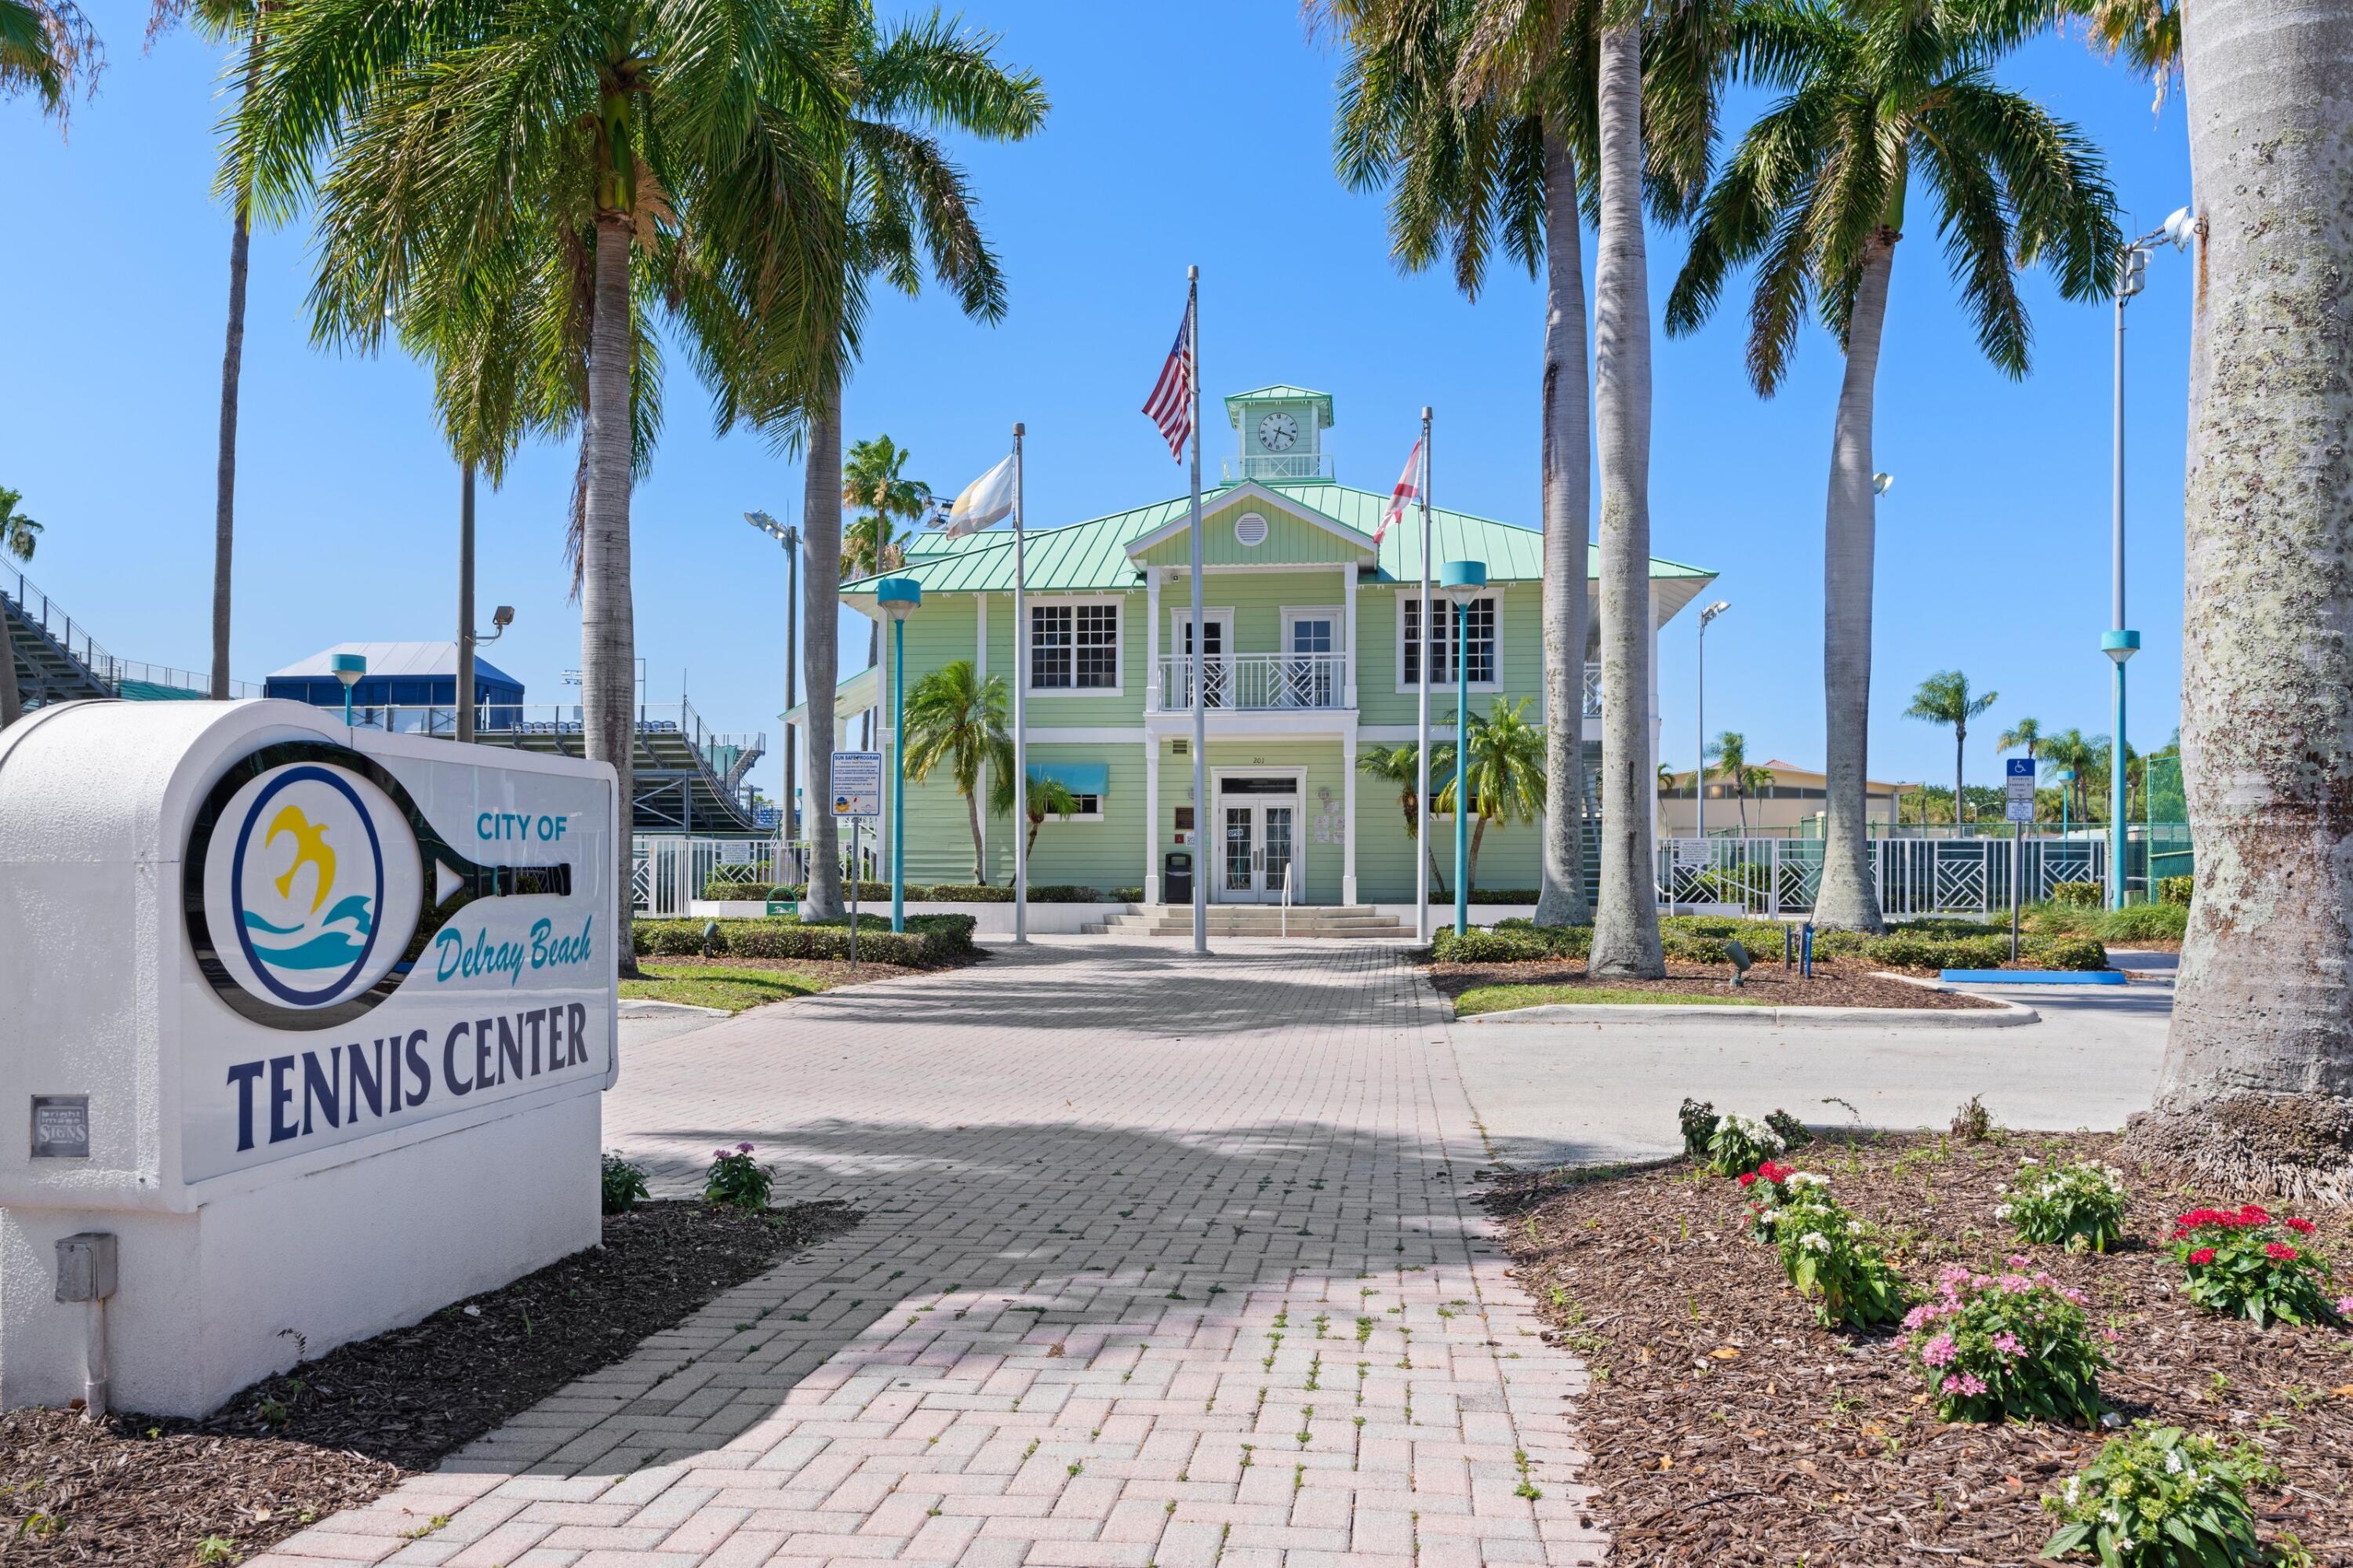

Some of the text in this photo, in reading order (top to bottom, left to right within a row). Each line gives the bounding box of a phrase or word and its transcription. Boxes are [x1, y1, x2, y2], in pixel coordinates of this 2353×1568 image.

[477, 812, 567, 842] CITY OF
[436, 914, 591, 987] Delray Beach
[227, 1002, 589, 1152] TENNIS CENTER
[39, 1124, 86, 1143] SIGNS
